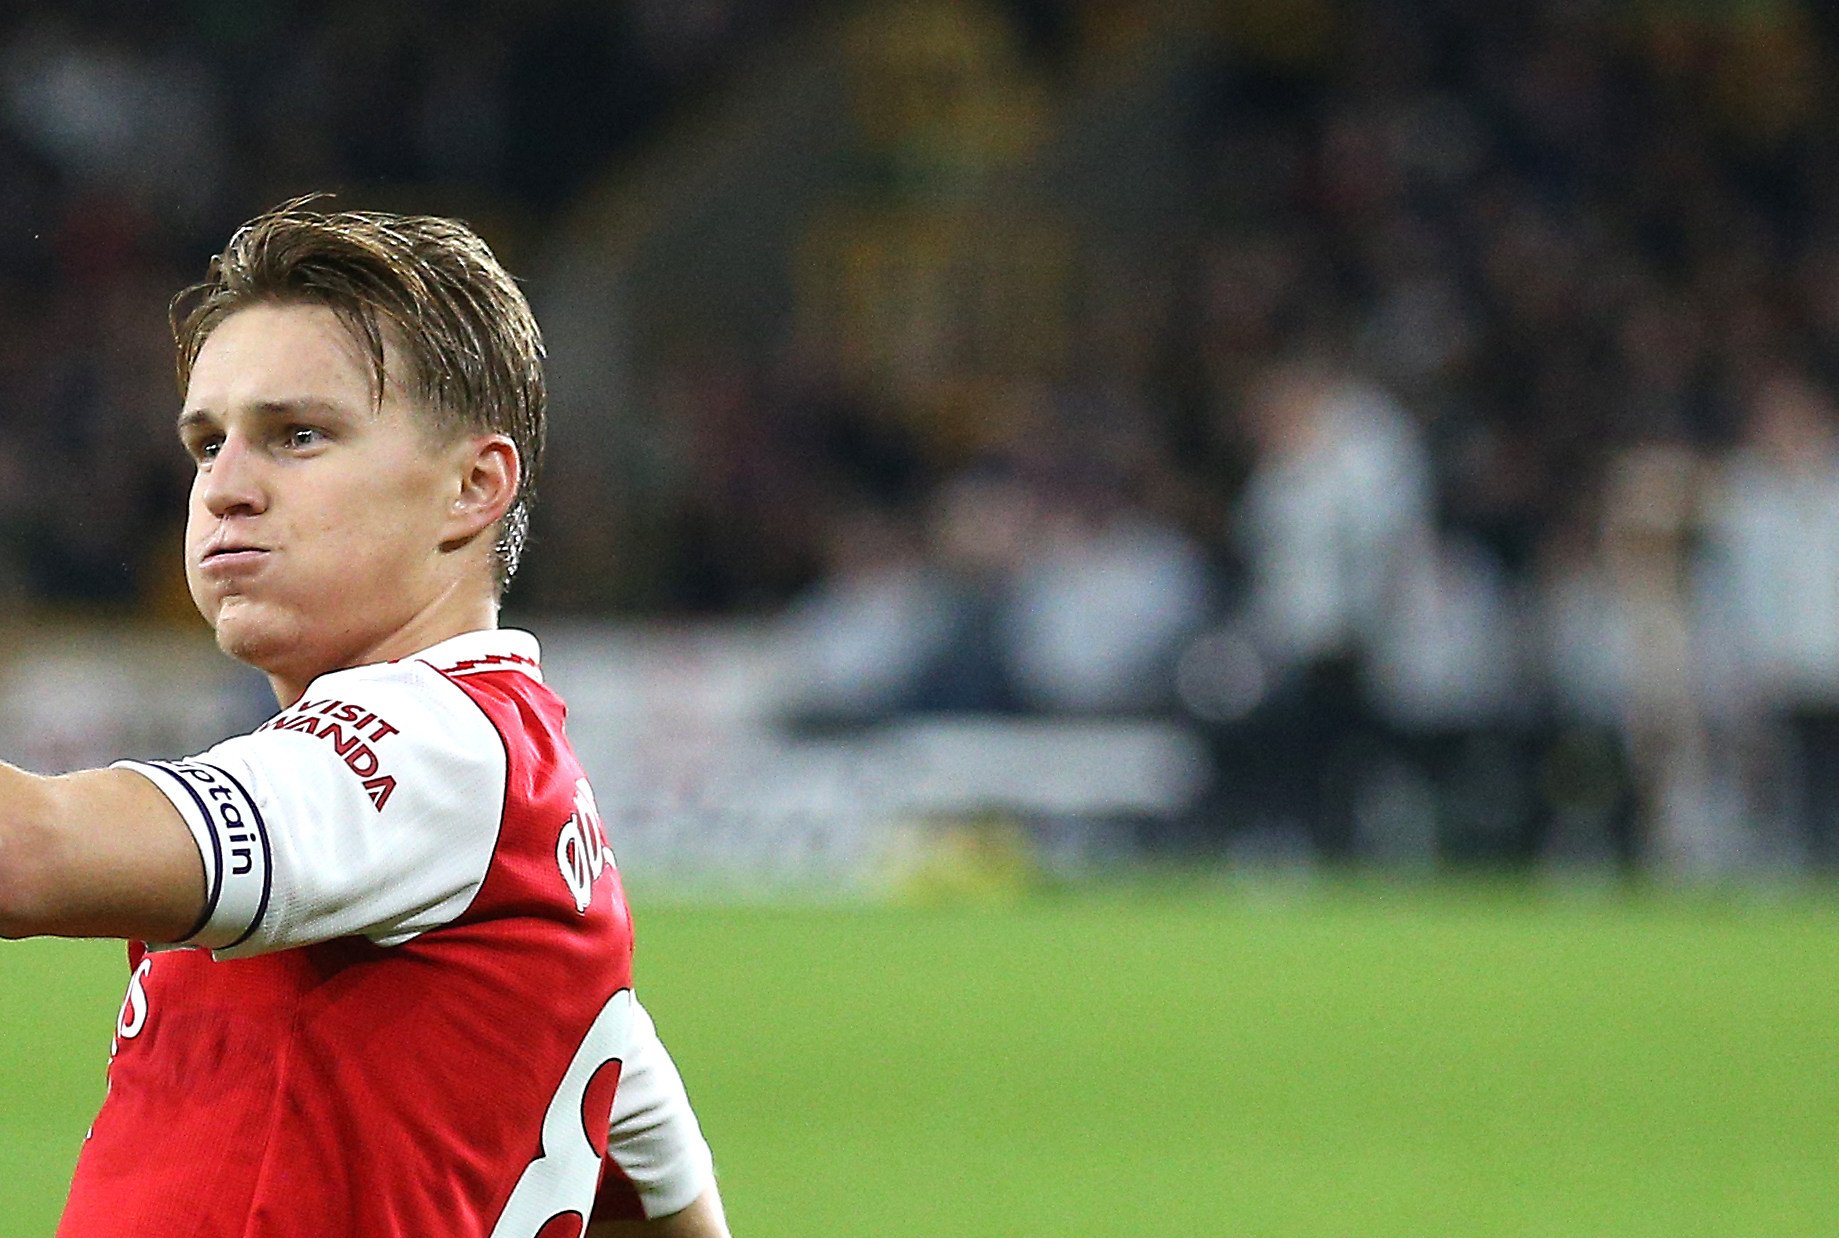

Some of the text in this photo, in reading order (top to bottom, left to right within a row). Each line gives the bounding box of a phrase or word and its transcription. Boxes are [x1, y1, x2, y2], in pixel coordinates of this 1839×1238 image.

[258, 714, 397, 813] WANDA
[298, 699, 400, 743] VISIT
[168, 761, 253, 875] ptain
